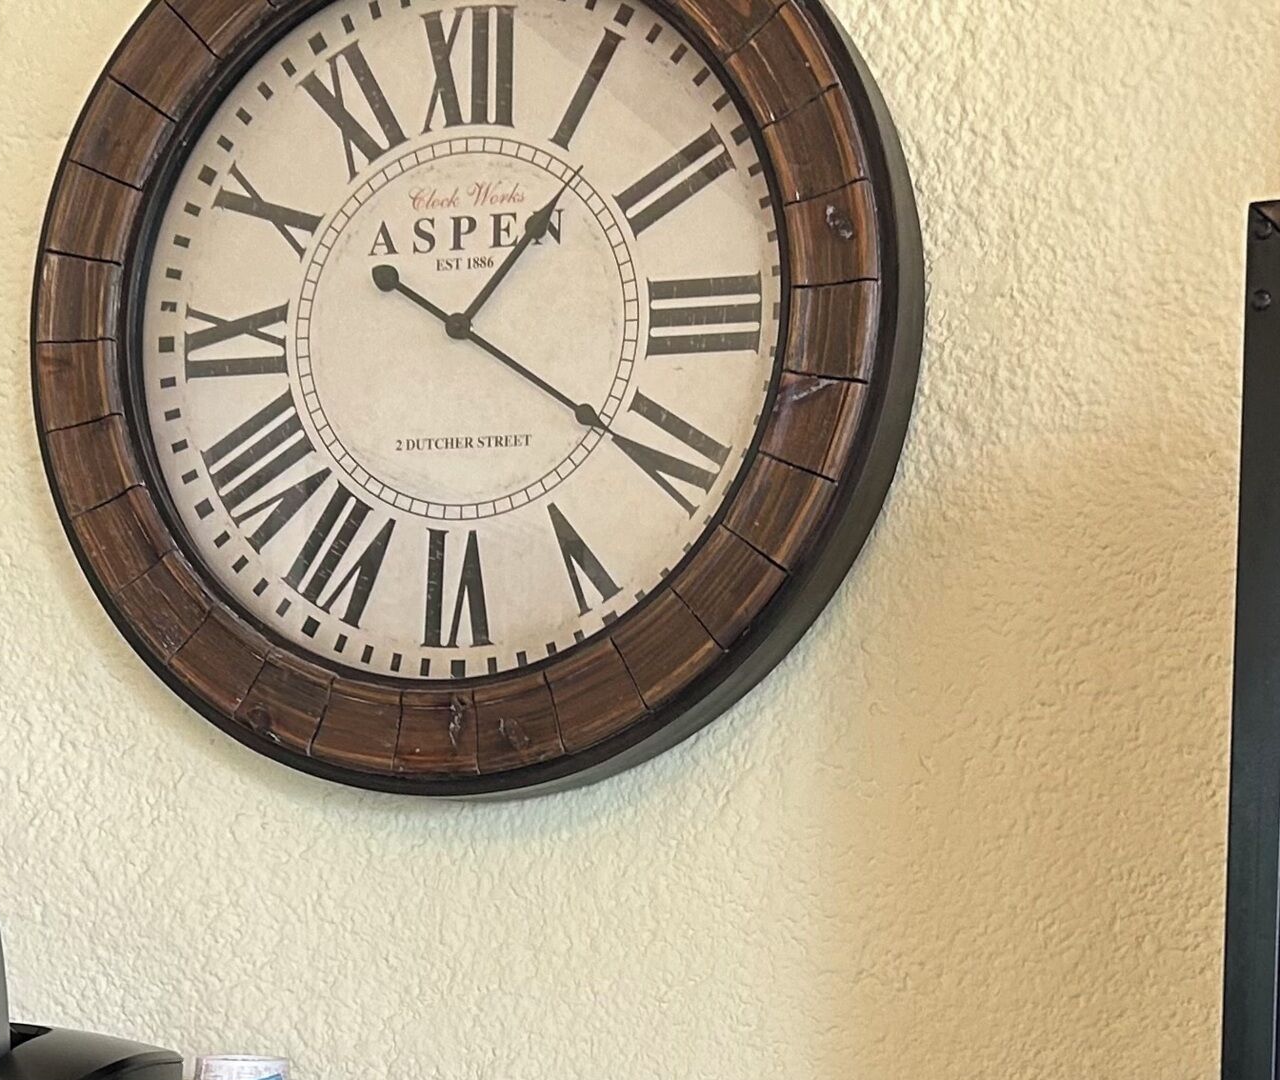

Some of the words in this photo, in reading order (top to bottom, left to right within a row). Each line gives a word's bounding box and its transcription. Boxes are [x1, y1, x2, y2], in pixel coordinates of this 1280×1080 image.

[297, 40, 410, 181] XI
[420, 4, 516, 135] XII
[550, 27, 625, 150] I
[212, 162, 326, 260] X
[368, 208, 564, 256] ASPEN
[409, 187, 460, 211] Clock
[467, 181, 526, 208] Works
[614, 124, 737, 239] II
[436, 258, 463, 271] EST
[467, 256, 494, 270] 1886
[645, 271, 762, 357] III
[184, 298, 291, 382] IX
[199, 383, 331, 554] VIII
[395, 439, 403, 451] 2
[405, 437, 474, 451] DUTCHER
[477, 434, 532, 448] STREET
[608, 388, 733, 519] IV
[280, 478, 397, 630] VII
[419, 527, 491, 649] VI
[547, 502, 624, 617] V
